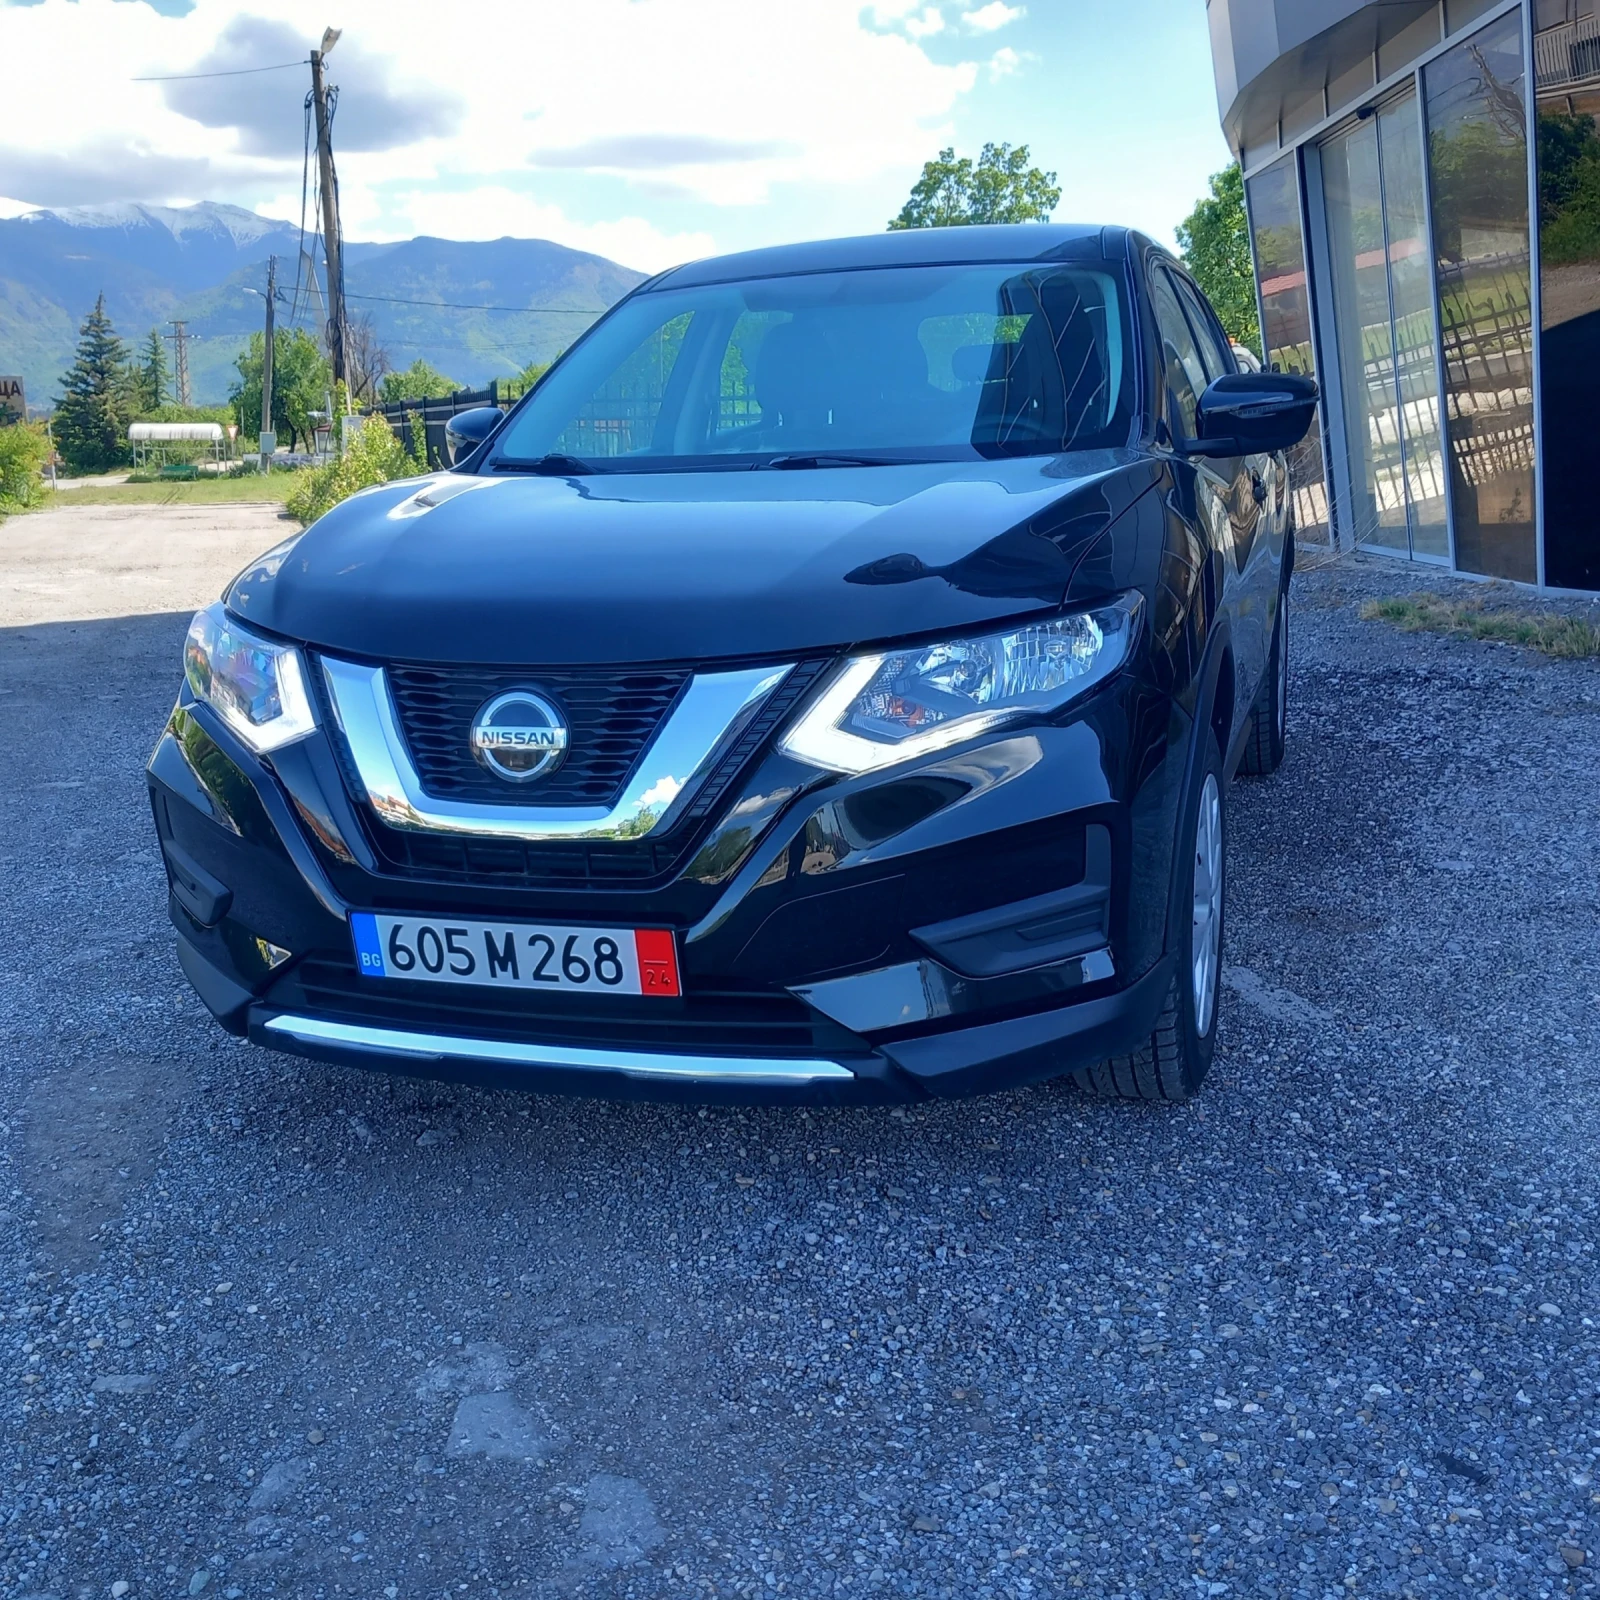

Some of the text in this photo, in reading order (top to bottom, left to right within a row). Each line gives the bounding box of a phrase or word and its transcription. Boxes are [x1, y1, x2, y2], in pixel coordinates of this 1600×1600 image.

[481, 731, 555, 745] NISSAN
[361, 952, 381, 967] BG
[388, 924, 623, 985] 605 M 268
[645, 968, 671, 987] 24
